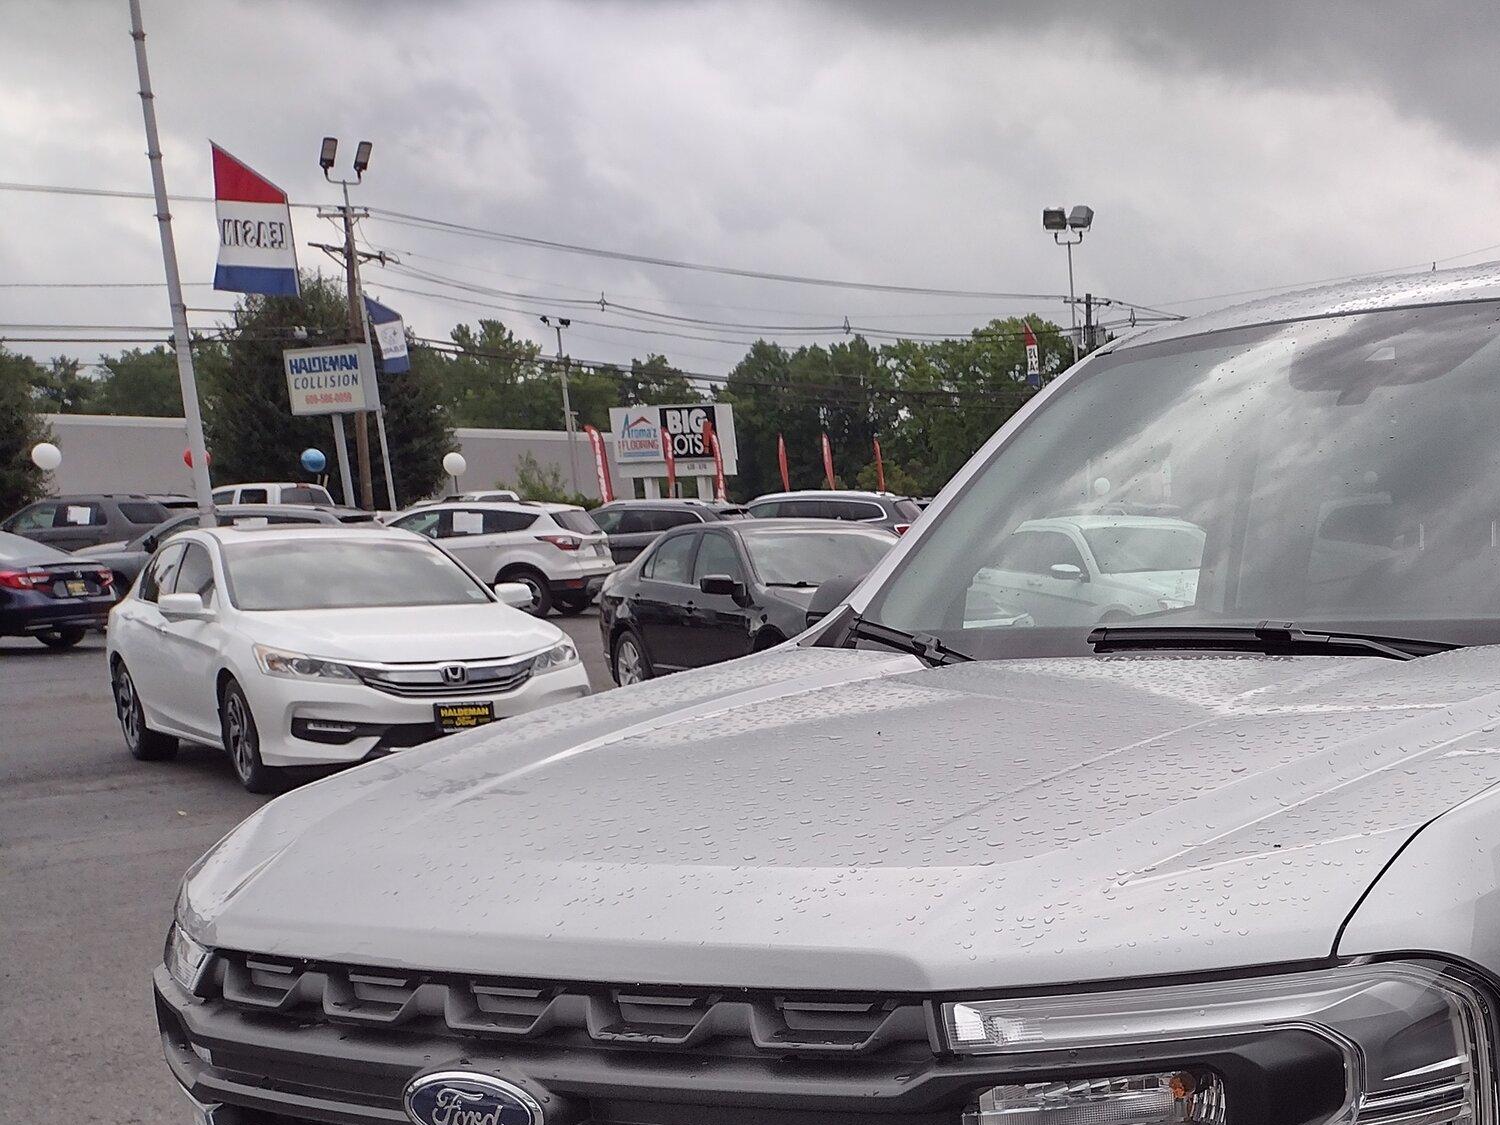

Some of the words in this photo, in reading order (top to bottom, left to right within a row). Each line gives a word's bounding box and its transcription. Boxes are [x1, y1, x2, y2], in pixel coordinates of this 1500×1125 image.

[289, 354, 359, 375] HALDEMAN
[294, 374, 359, 390] COLLISION
[666, 408, 708, 434] BIG
